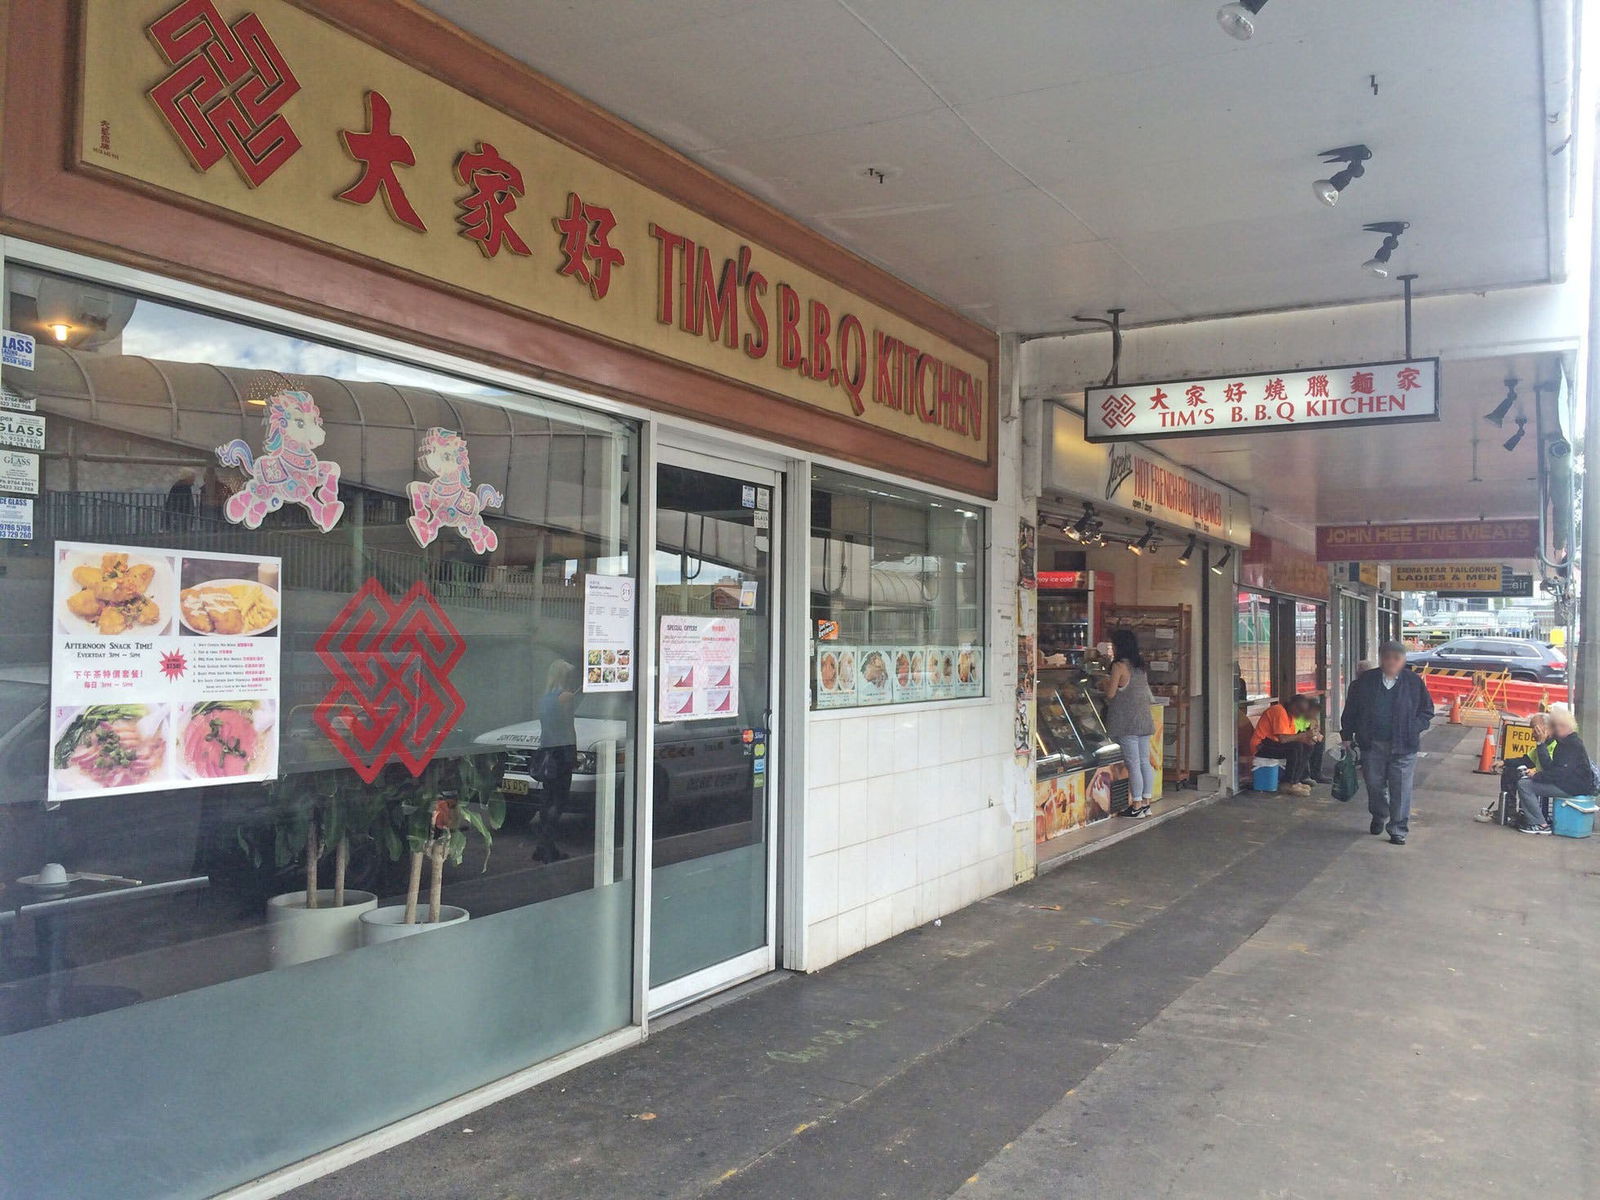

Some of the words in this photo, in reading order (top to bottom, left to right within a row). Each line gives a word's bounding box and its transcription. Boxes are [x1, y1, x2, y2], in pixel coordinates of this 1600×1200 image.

[333, 89, 626, 300] 大家好
[649, 223, 769, 359] TIM'S
[777, 281, 868, 416] B.B.Q
[873, 329, 983, 441] KITCHEN
[1159, 408, 1215, 428] TIM'S
[1306, 394, 1407, 417] KITCHEN
[0, 422, 43, 437] GLASS
[3, 456, 31, 466] GLASS
[1134, 456, 1149, 500] HOT
[8, 498, 27, 506] GLASS
[1327, 527, 1372, 543] JOHN
[1375, 527, 1413, 543] HEE
[1416, 526, 1457, 542] FINE
[1461, 523, 1530, 541] MEATS
[1424, 566, 1447, 574] STAR
[64, 641, 106, 650] AFTERNOON
[109, 642, 131, 650] SNACK
